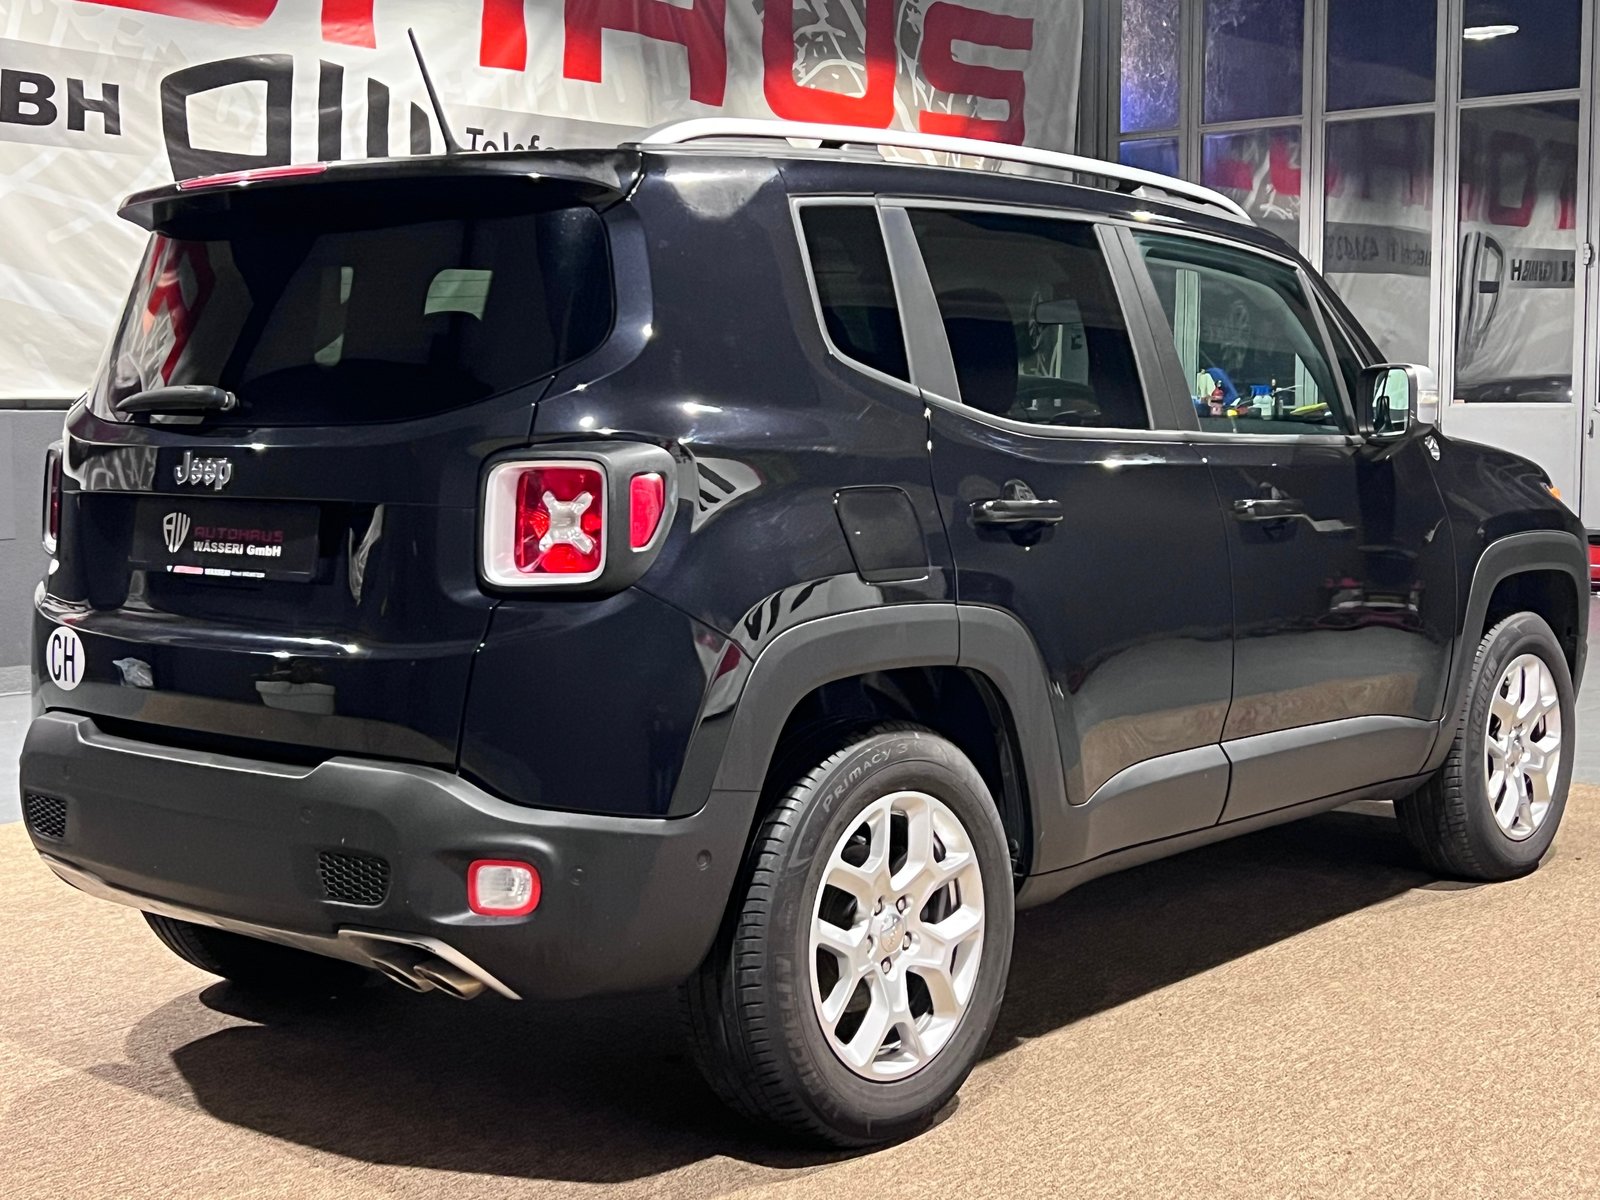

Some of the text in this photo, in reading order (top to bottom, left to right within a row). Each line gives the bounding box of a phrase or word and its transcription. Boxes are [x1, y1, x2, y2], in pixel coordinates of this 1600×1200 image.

[174, 450, 232, 491] Jeep
[193, 540, 282, 557] WÄSSERI GmbH
[194, 526, 283, 543] AUTOHAUS
[52, 633, 75, 683] CH
[822, 743, 908, 813] PRIMACY 3
